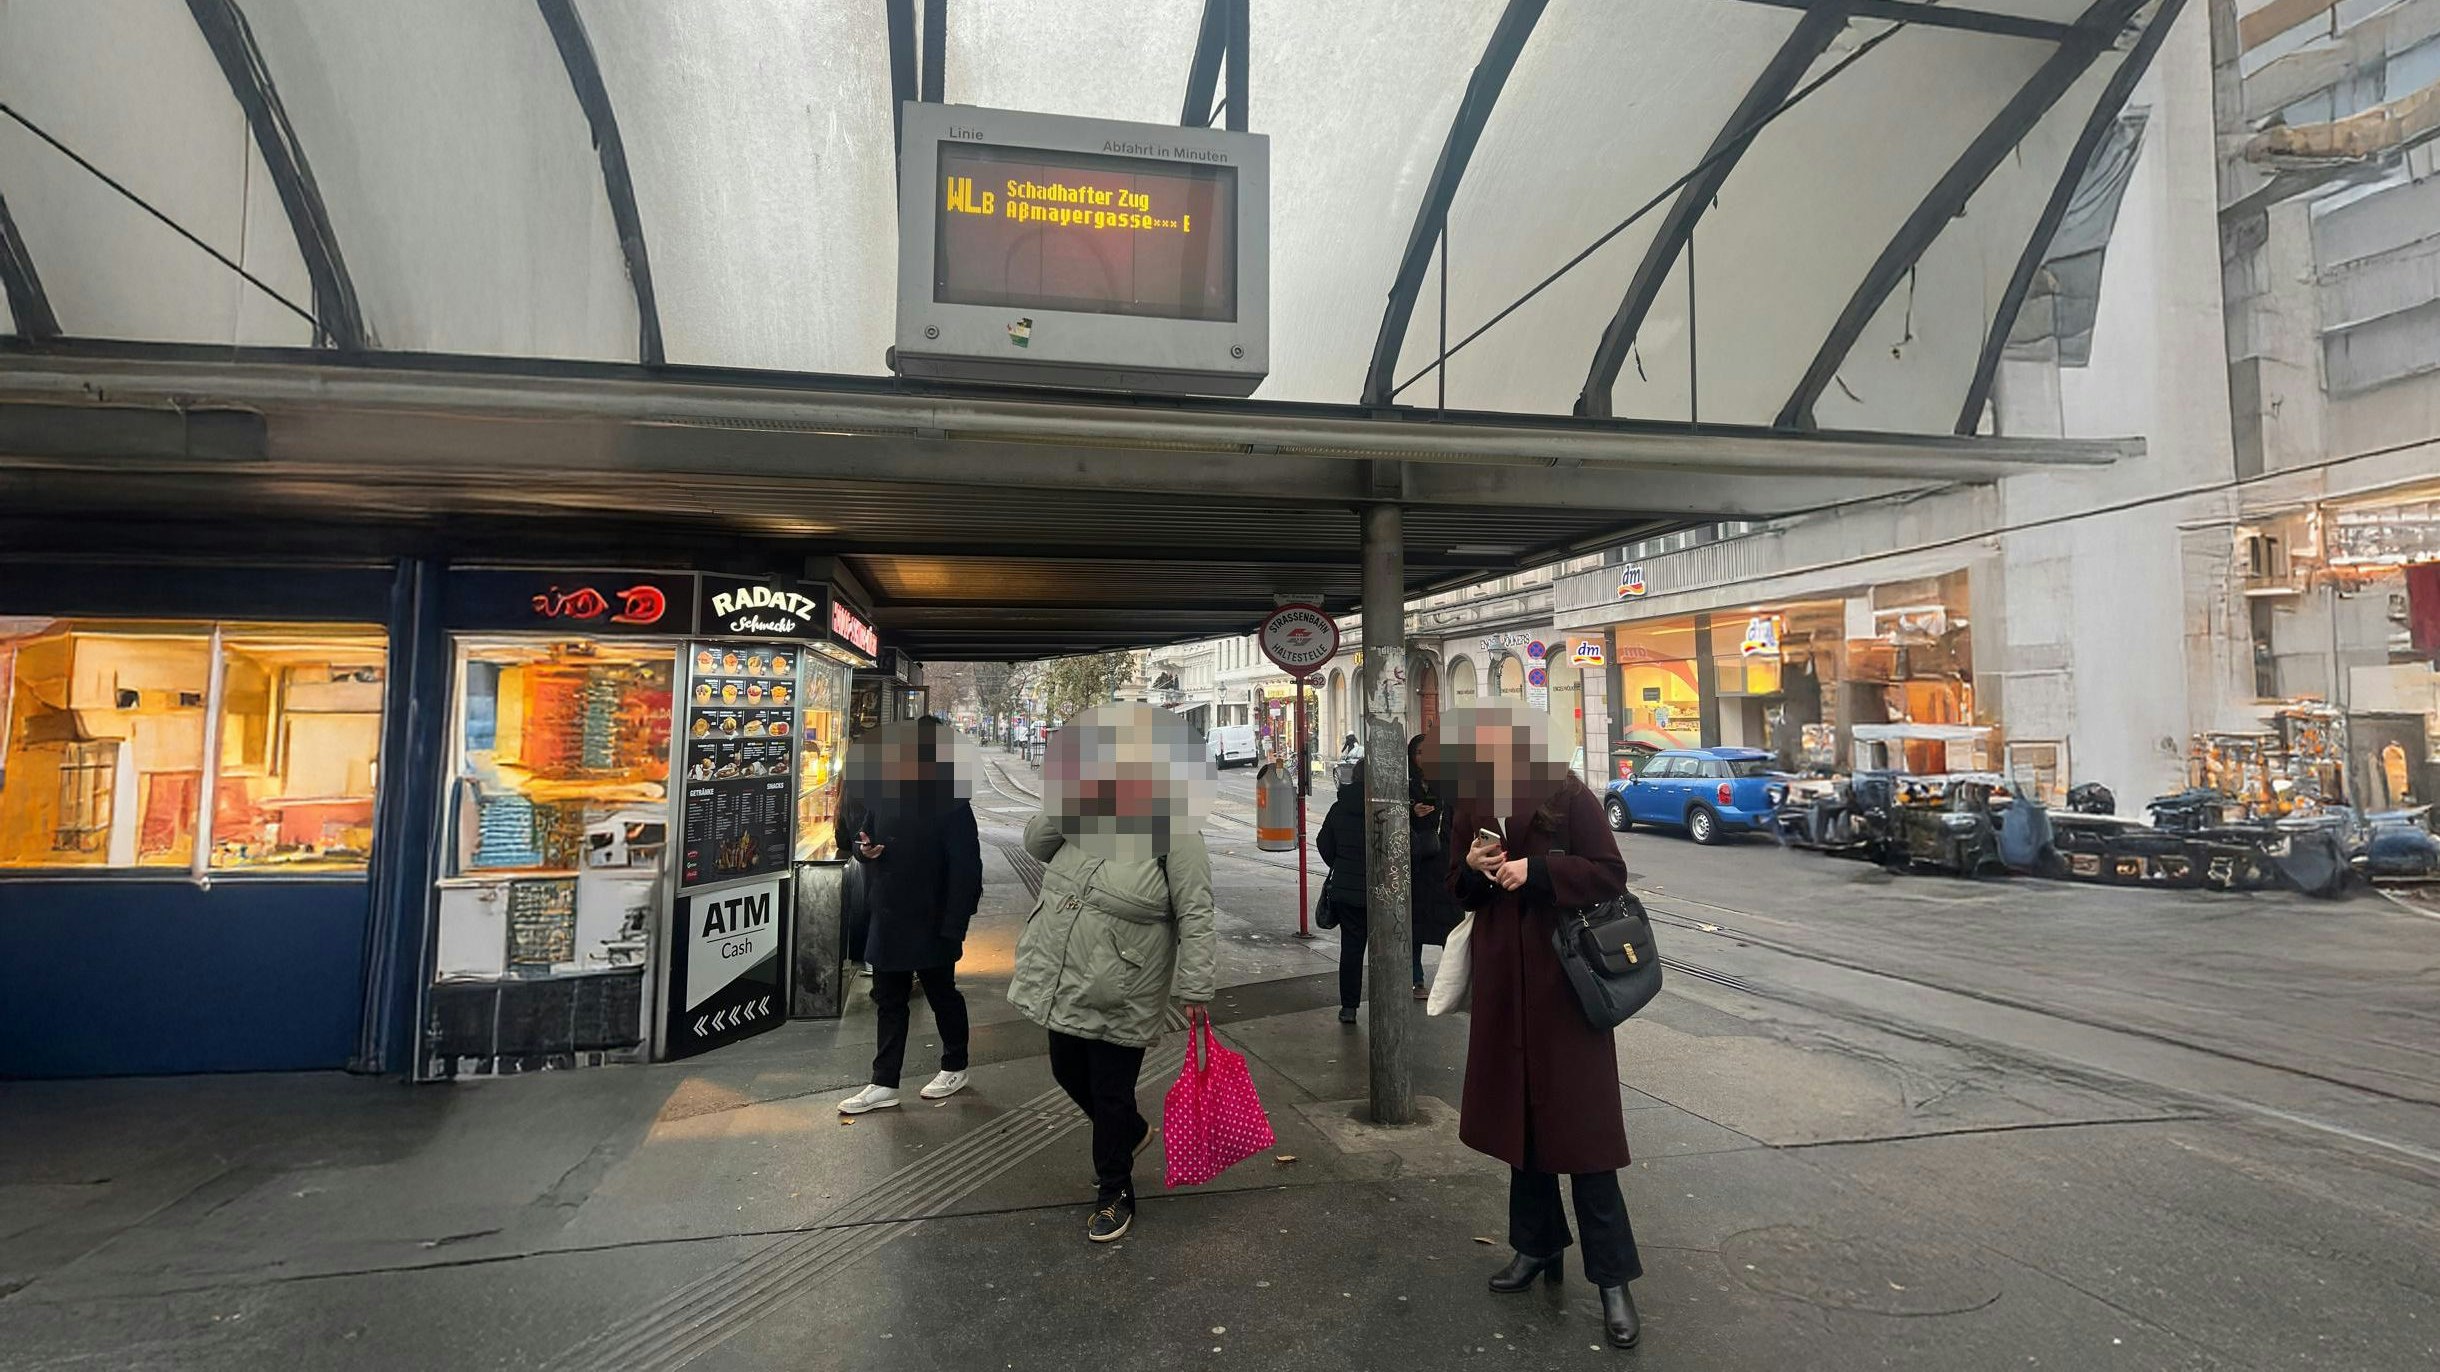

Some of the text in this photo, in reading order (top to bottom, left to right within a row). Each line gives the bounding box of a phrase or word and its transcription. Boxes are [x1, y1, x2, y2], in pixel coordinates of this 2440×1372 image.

[949, 127, 984, 141] Linie
[1103, 140, 1228, 163] Abfahrt in Minuten
[947, 176, 995, 215] WLB
[1007, 179, 1150, 212] Schadhafter Zug
[1622, 565, 1642, 586] dm
[712, 586, 816, 621] RADATZ
[1269, 612, 1330, 634] STRASSENBAHN
[1271, 643, 1327, 662] HALTESTELLE
[1577, 642, 1600, 656] dm
[702, 892, 770, 938] ATM
[721, 937, 753, 959] Cash
